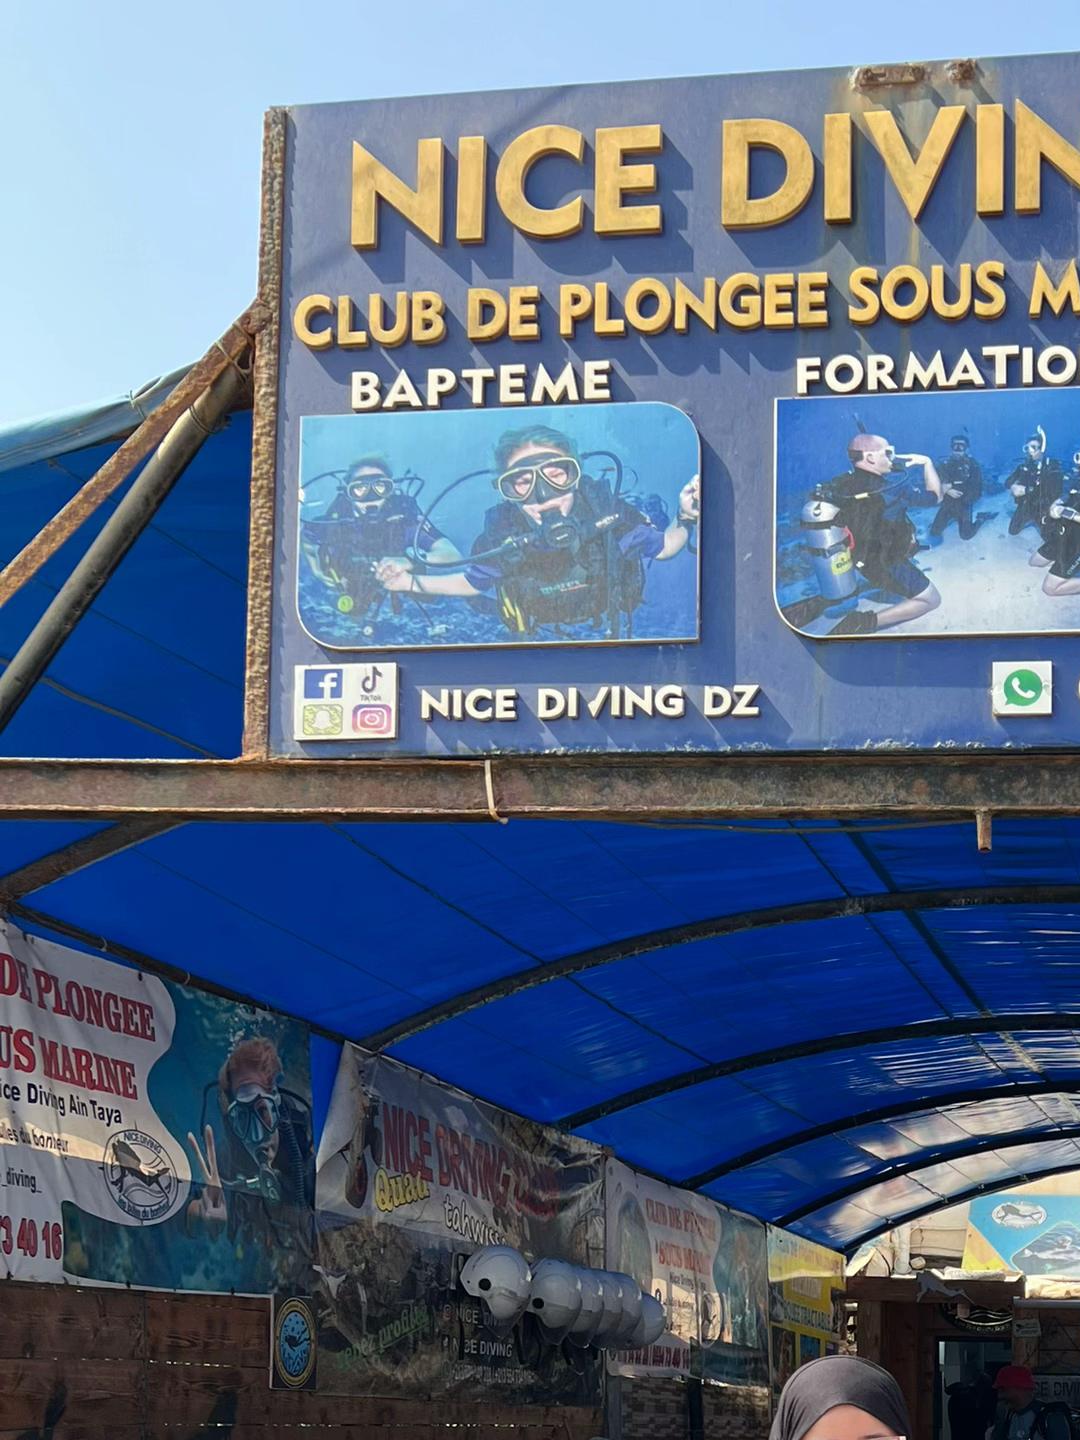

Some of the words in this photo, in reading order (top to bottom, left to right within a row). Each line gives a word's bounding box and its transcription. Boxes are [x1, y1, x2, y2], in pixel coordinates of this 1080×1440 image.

[350, 124, 665, 248] NICE
[294, 290, 446, 348] CLUB
[466, 285, 540, 343] DE
[558, 272, 829, 338] PLONGEE
[847, 262, 1006, 325] SOUS
[351, 361, 612, 411] BAPTEME
[421, 688, 517, 721] NICE
[704, 684, 760, 718] DZ
[0, 953, 32, 1003] DE
[33, 968, 156, 1041] PLONGEE
[38, 1036, 138, 1100] MARINE
[27, 1083, 65, 1116] Diving
[70, 1094, 88, 1117] Ain
[90, 1101, 122, 1127] Taya
[383, 1102, 434, 1183] NICE
[17, 1218, 38, 1257] 40
[42, 1221, 62, 1260] 16
[452, 1337, 478, 1354] NCE
[480, 1341, 512, 1358] DIVING
